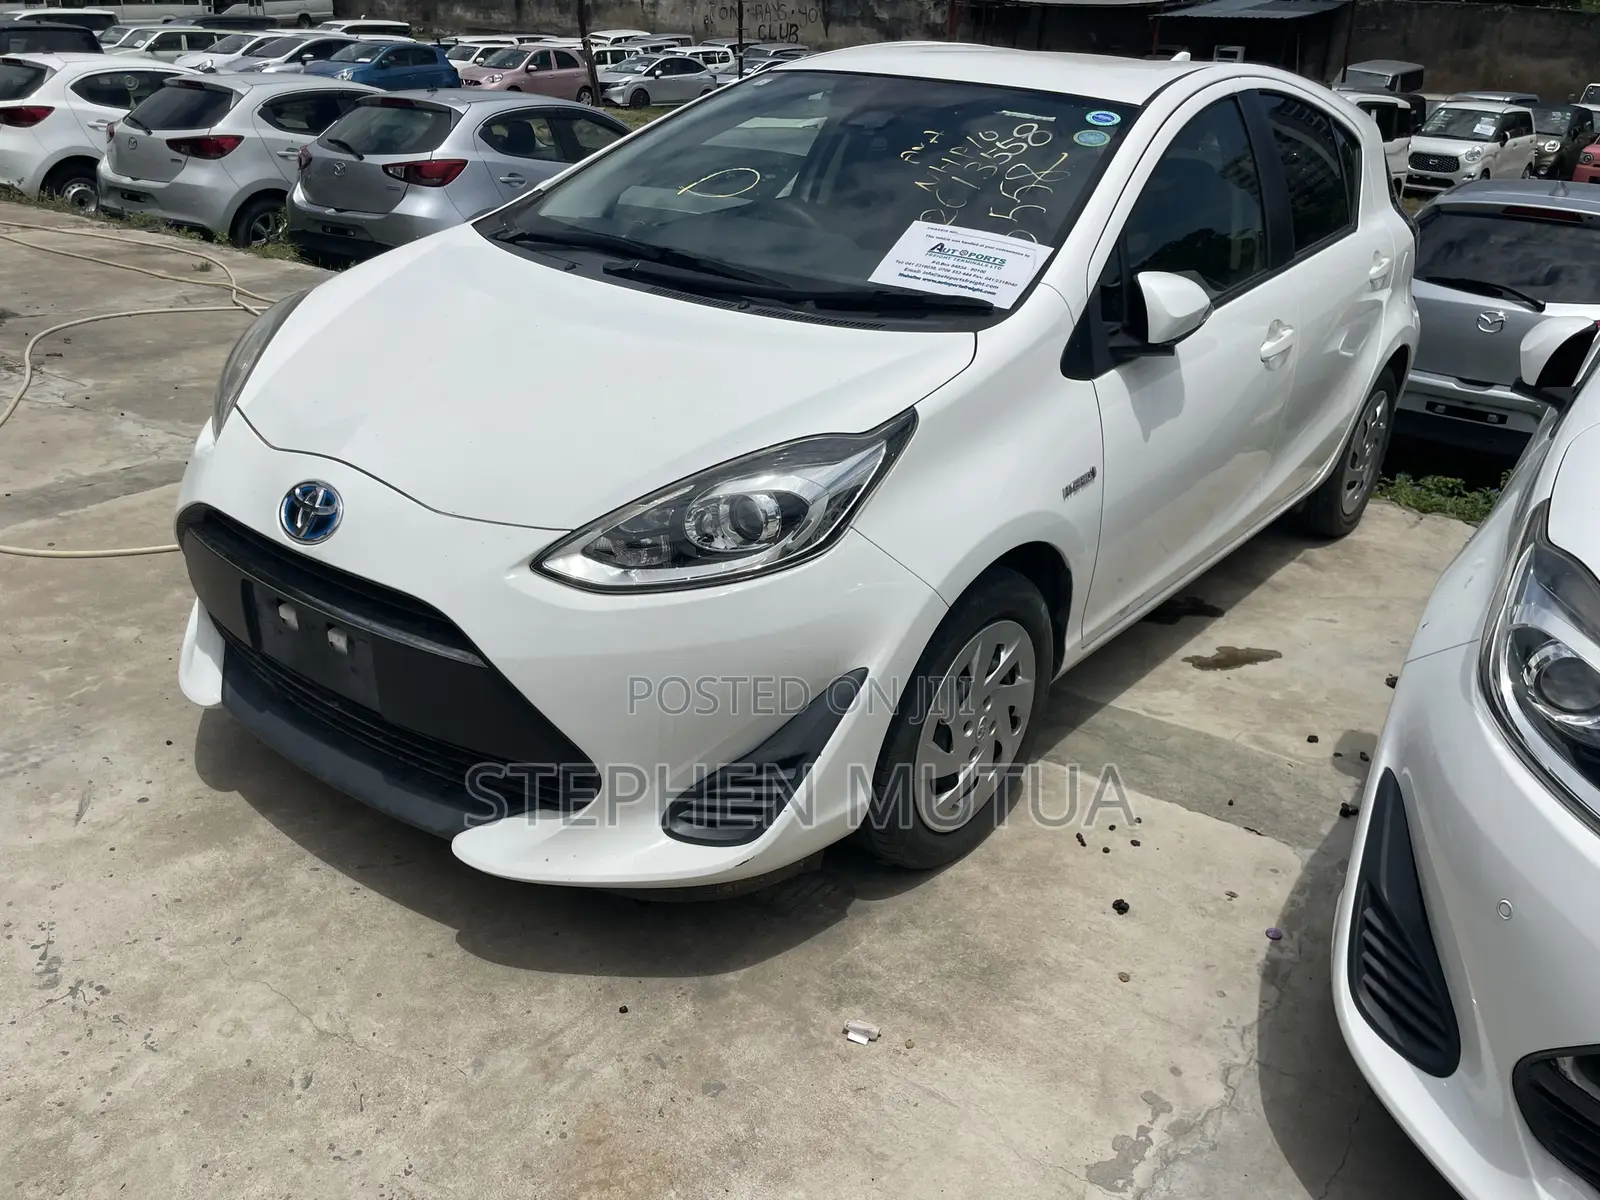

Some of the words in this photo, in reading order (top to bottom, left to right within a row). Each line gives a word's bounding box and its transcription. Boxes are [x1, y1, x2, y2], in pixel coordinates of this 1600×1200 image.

[758, 23, 799, 44] CLUB
[924, 252, 951, 261] FREIGHT
[953, 256, 989, 268] TERMINALS
